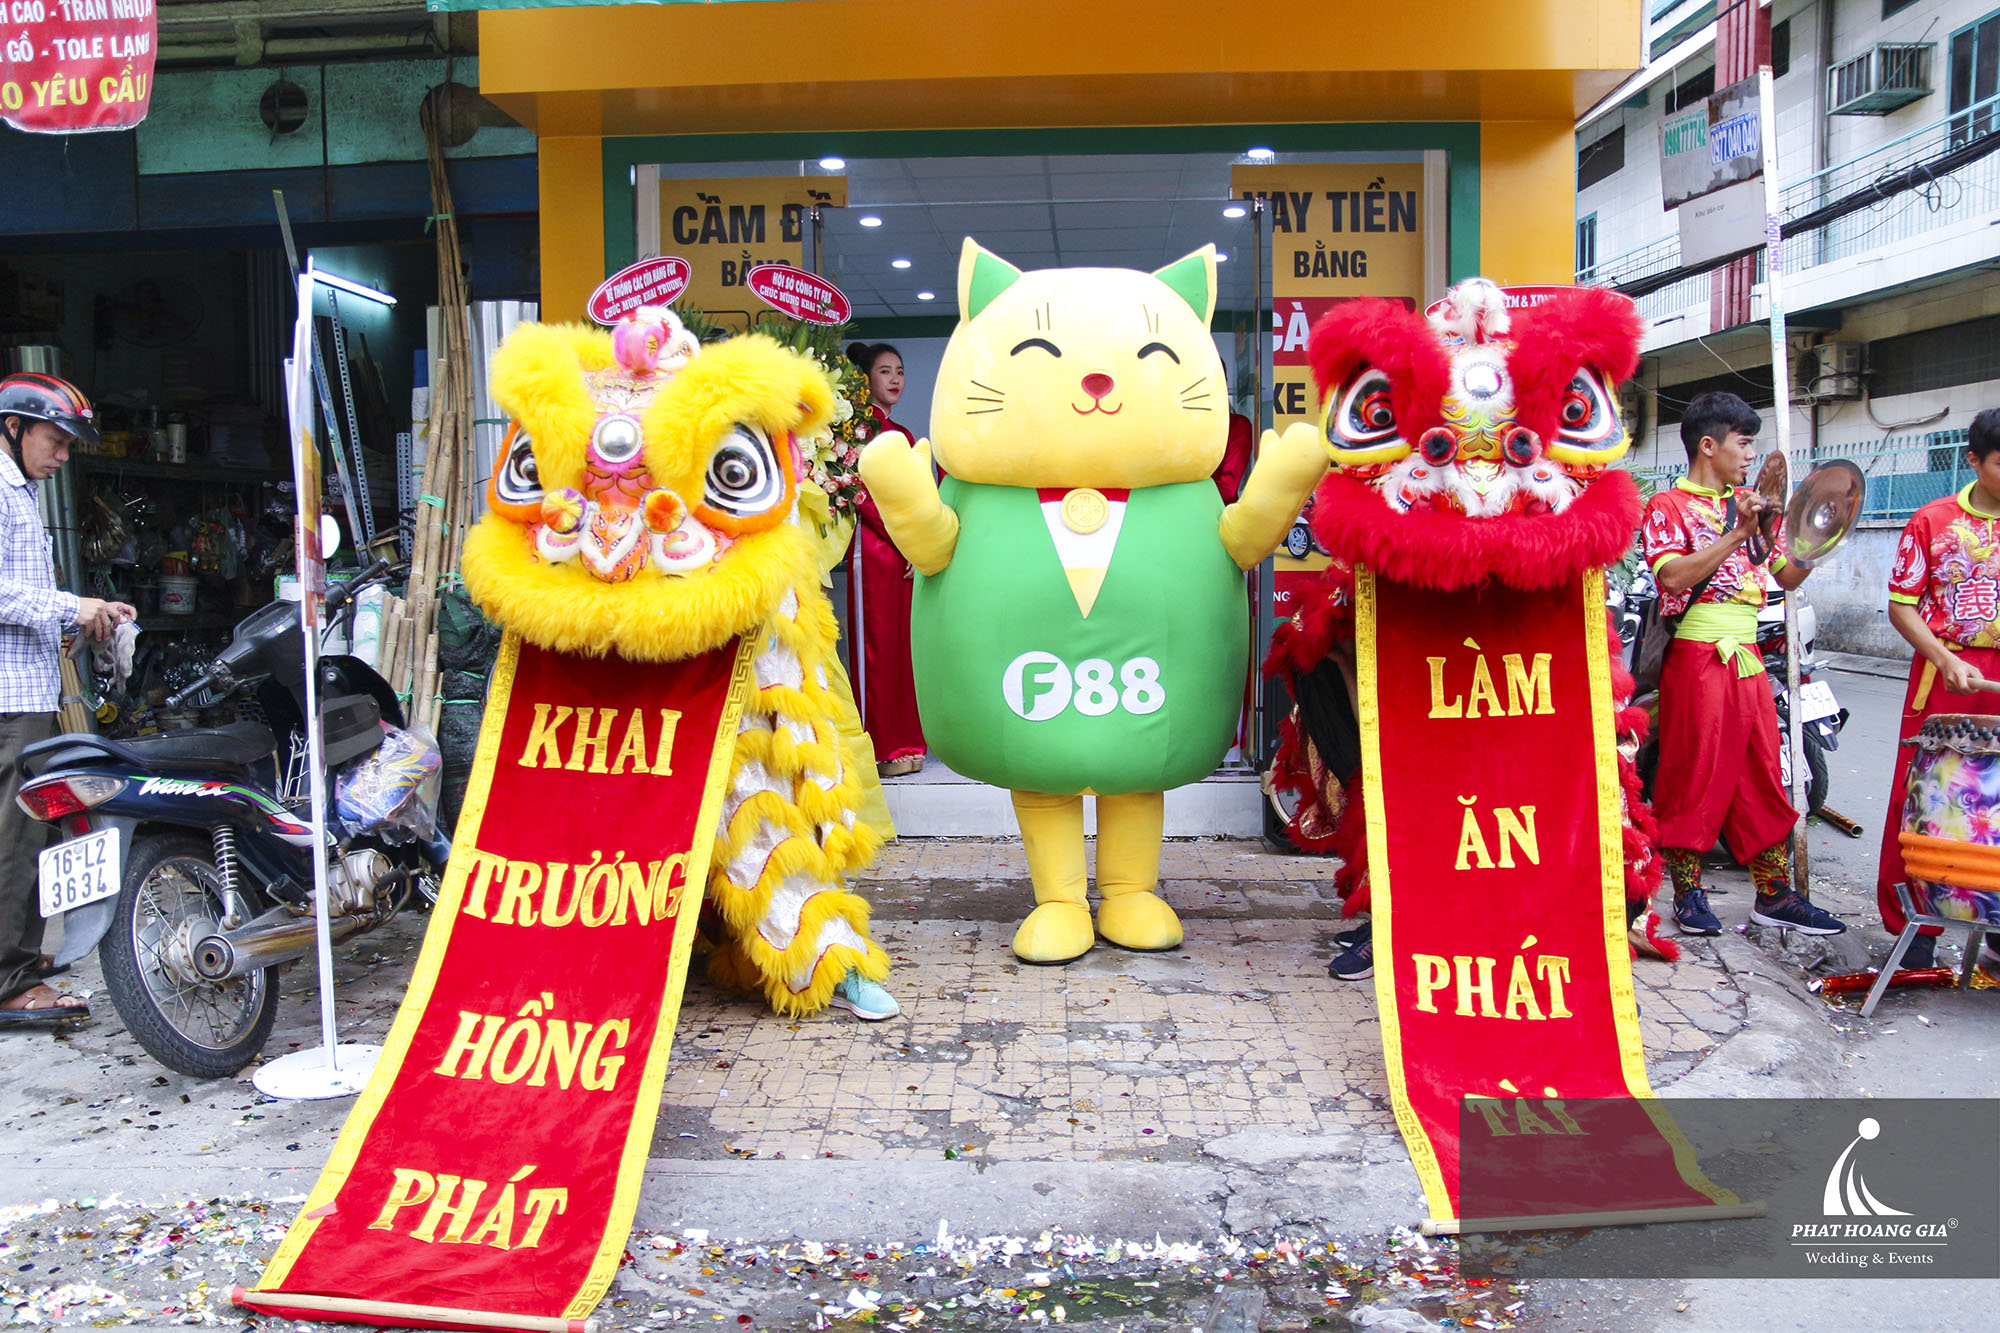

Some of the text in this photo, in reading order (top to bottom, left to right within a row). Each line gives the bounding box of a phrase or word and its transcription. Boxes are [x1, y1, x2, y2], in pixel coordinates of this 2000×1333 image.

[12, 1, 45, 23] CAO
[52, 35, 104, 60] TOLE
[31, 72, 89, 107] YÊU
[99, 64, 147, 104] CẦU
[673, 190, 833, 244] CẦM Đ
[1243, 177, 1417, 233] AY TIỀN
[1294, 240, 1367, 278] BẰNG
[643, 287, 658, 303] KHAI
[760, 285, 778, 300] CHÚC
[801, 298, 816, 312] KHAI
[795, 279, 813, 298] CÔNG
[813, 286, 821, 300] TY
[821, 289, 832, 304] F88
[1955, 576, 1998, 622] 義
[1003, 651, 1167, 721] F88
[1426, 637, 1556, 719] LÀM
[518, 703, 683, 777] KHAI
[53, 838, 107, 879] 16-L2
[1455, 795, 1541, 871] ĂN
[52, 867, 107, 909] 3634
[462, 850, 694, 928] TRƯƠNG
[1412, 934, 1573, 1020] PHÁT
[434, 992, 631, 1092] HỒNG
[1464, 1078, 1591, 1137] TÀI
[368, 1165, 568, 1251] PHÁT
